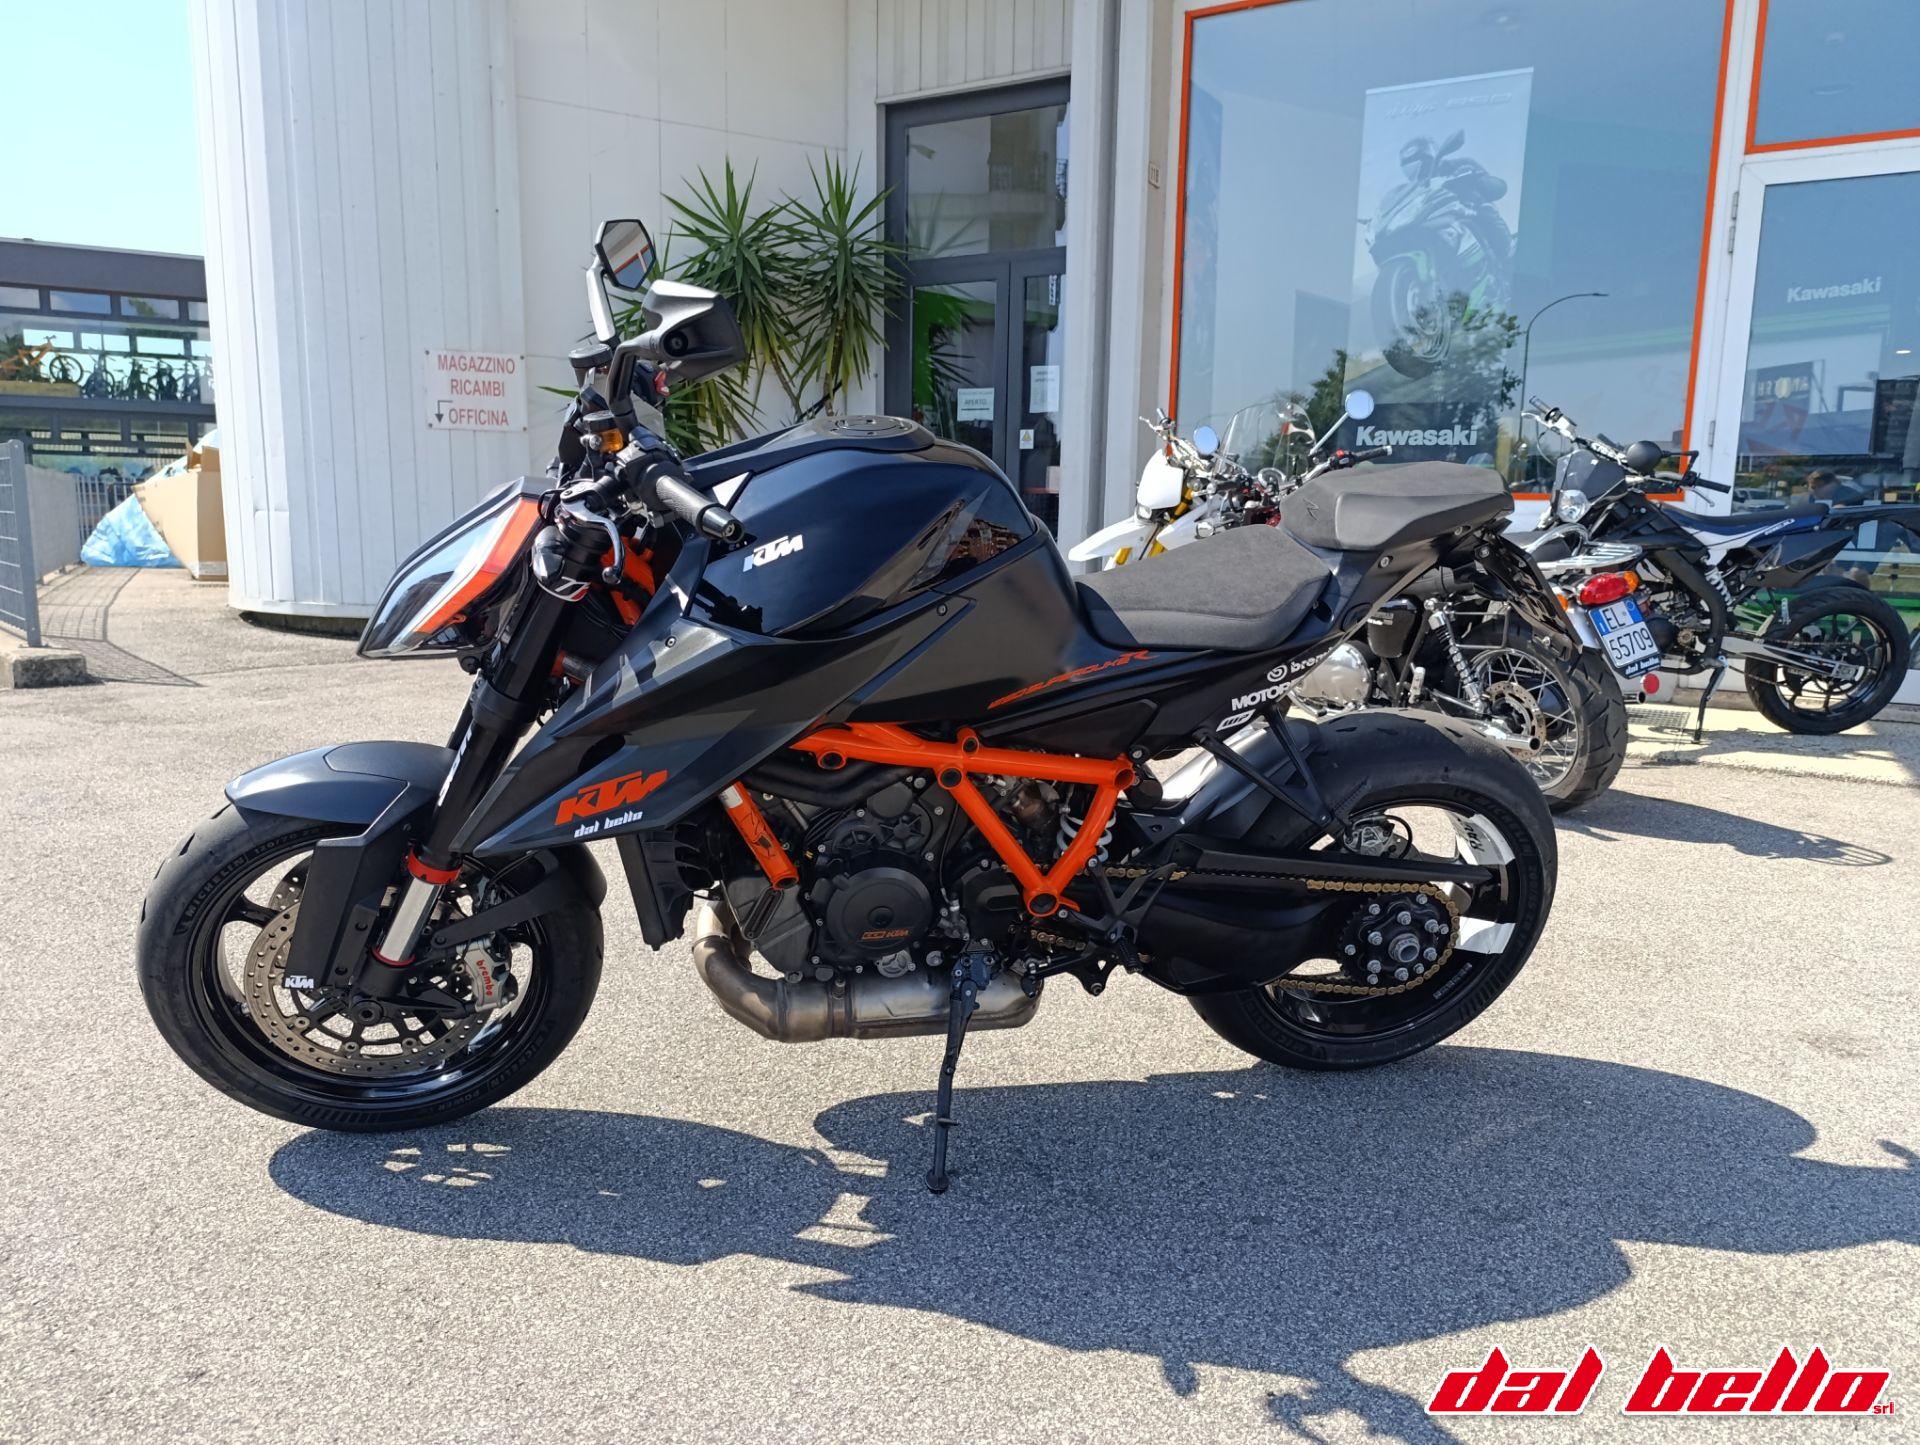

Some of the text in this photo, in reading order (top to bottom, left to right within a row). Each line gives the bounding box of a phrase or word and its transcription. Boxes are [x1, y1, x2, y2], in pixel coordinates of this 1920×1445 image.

[1786, 275, 1882, 303] Kawasaki
[437, 354, 515, 374] MAGAZZINO
[450, 378, 505, 397] RICAMBI
[448, 407, 509, 426] OFFICINA
[1356, 424, 1478, 446] Kawasaki
[743, 534, 804, 573] KTM
[1602, 607, 1626, 630] EL
[1609, 627, 1654, 660] 55709
[1290, 646, 1333, 674] bre
[1231, 682, 1291, 711] MOTOR
[555, 769, 668, 825] KTM
[573, 810, 643, 838] dal bello
[184, 855, 247, 920] MICHELIN
[285, 975, 315, 989] KTM
[475, 959, 494, 997] brembo
